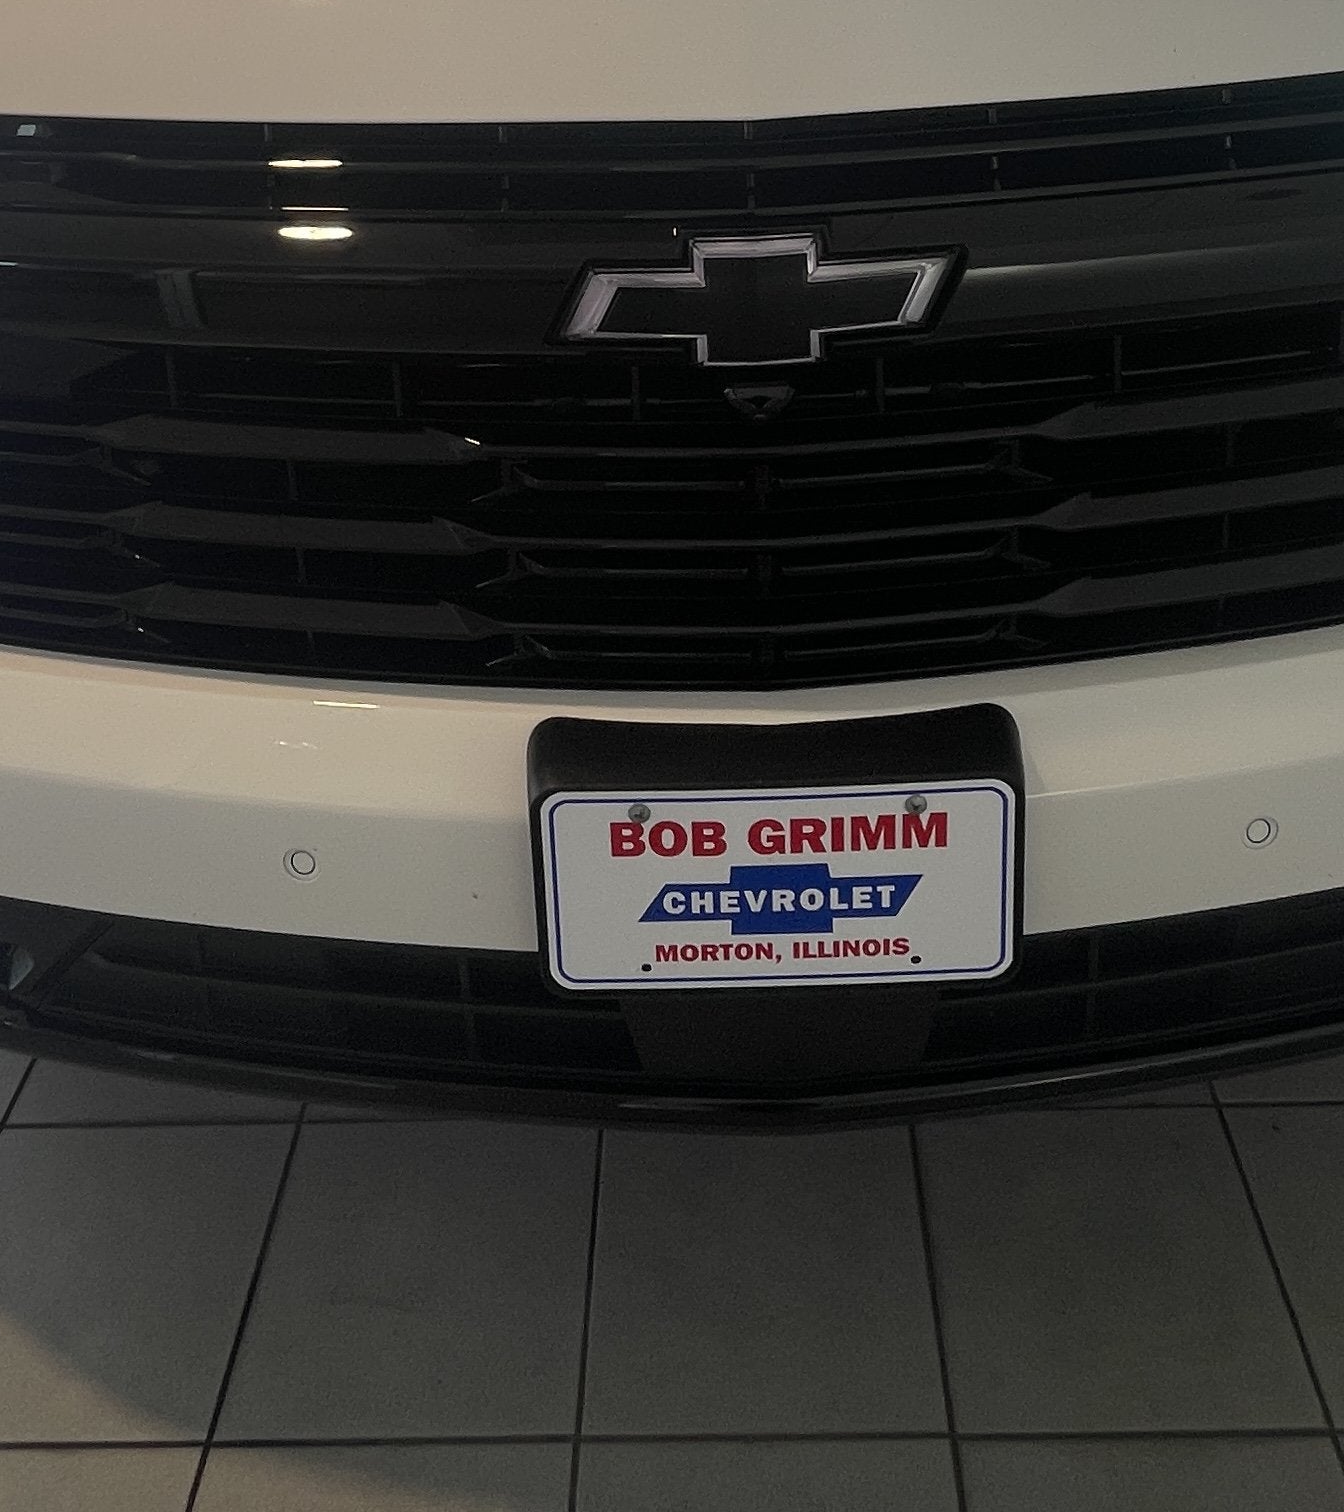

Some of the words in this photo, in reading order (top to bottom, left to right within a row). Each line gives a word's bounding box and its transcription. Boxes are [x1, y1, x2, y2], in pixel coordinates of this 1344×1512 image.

[609, 820, 728, 857] BOB
[748, 812, 948, 855] GRIMM
[662, 884, 896, 915] CHEVROLET
[655, 942, 782, 964] MORTON,
[792, 937, 910, 960] ILLINOIS
